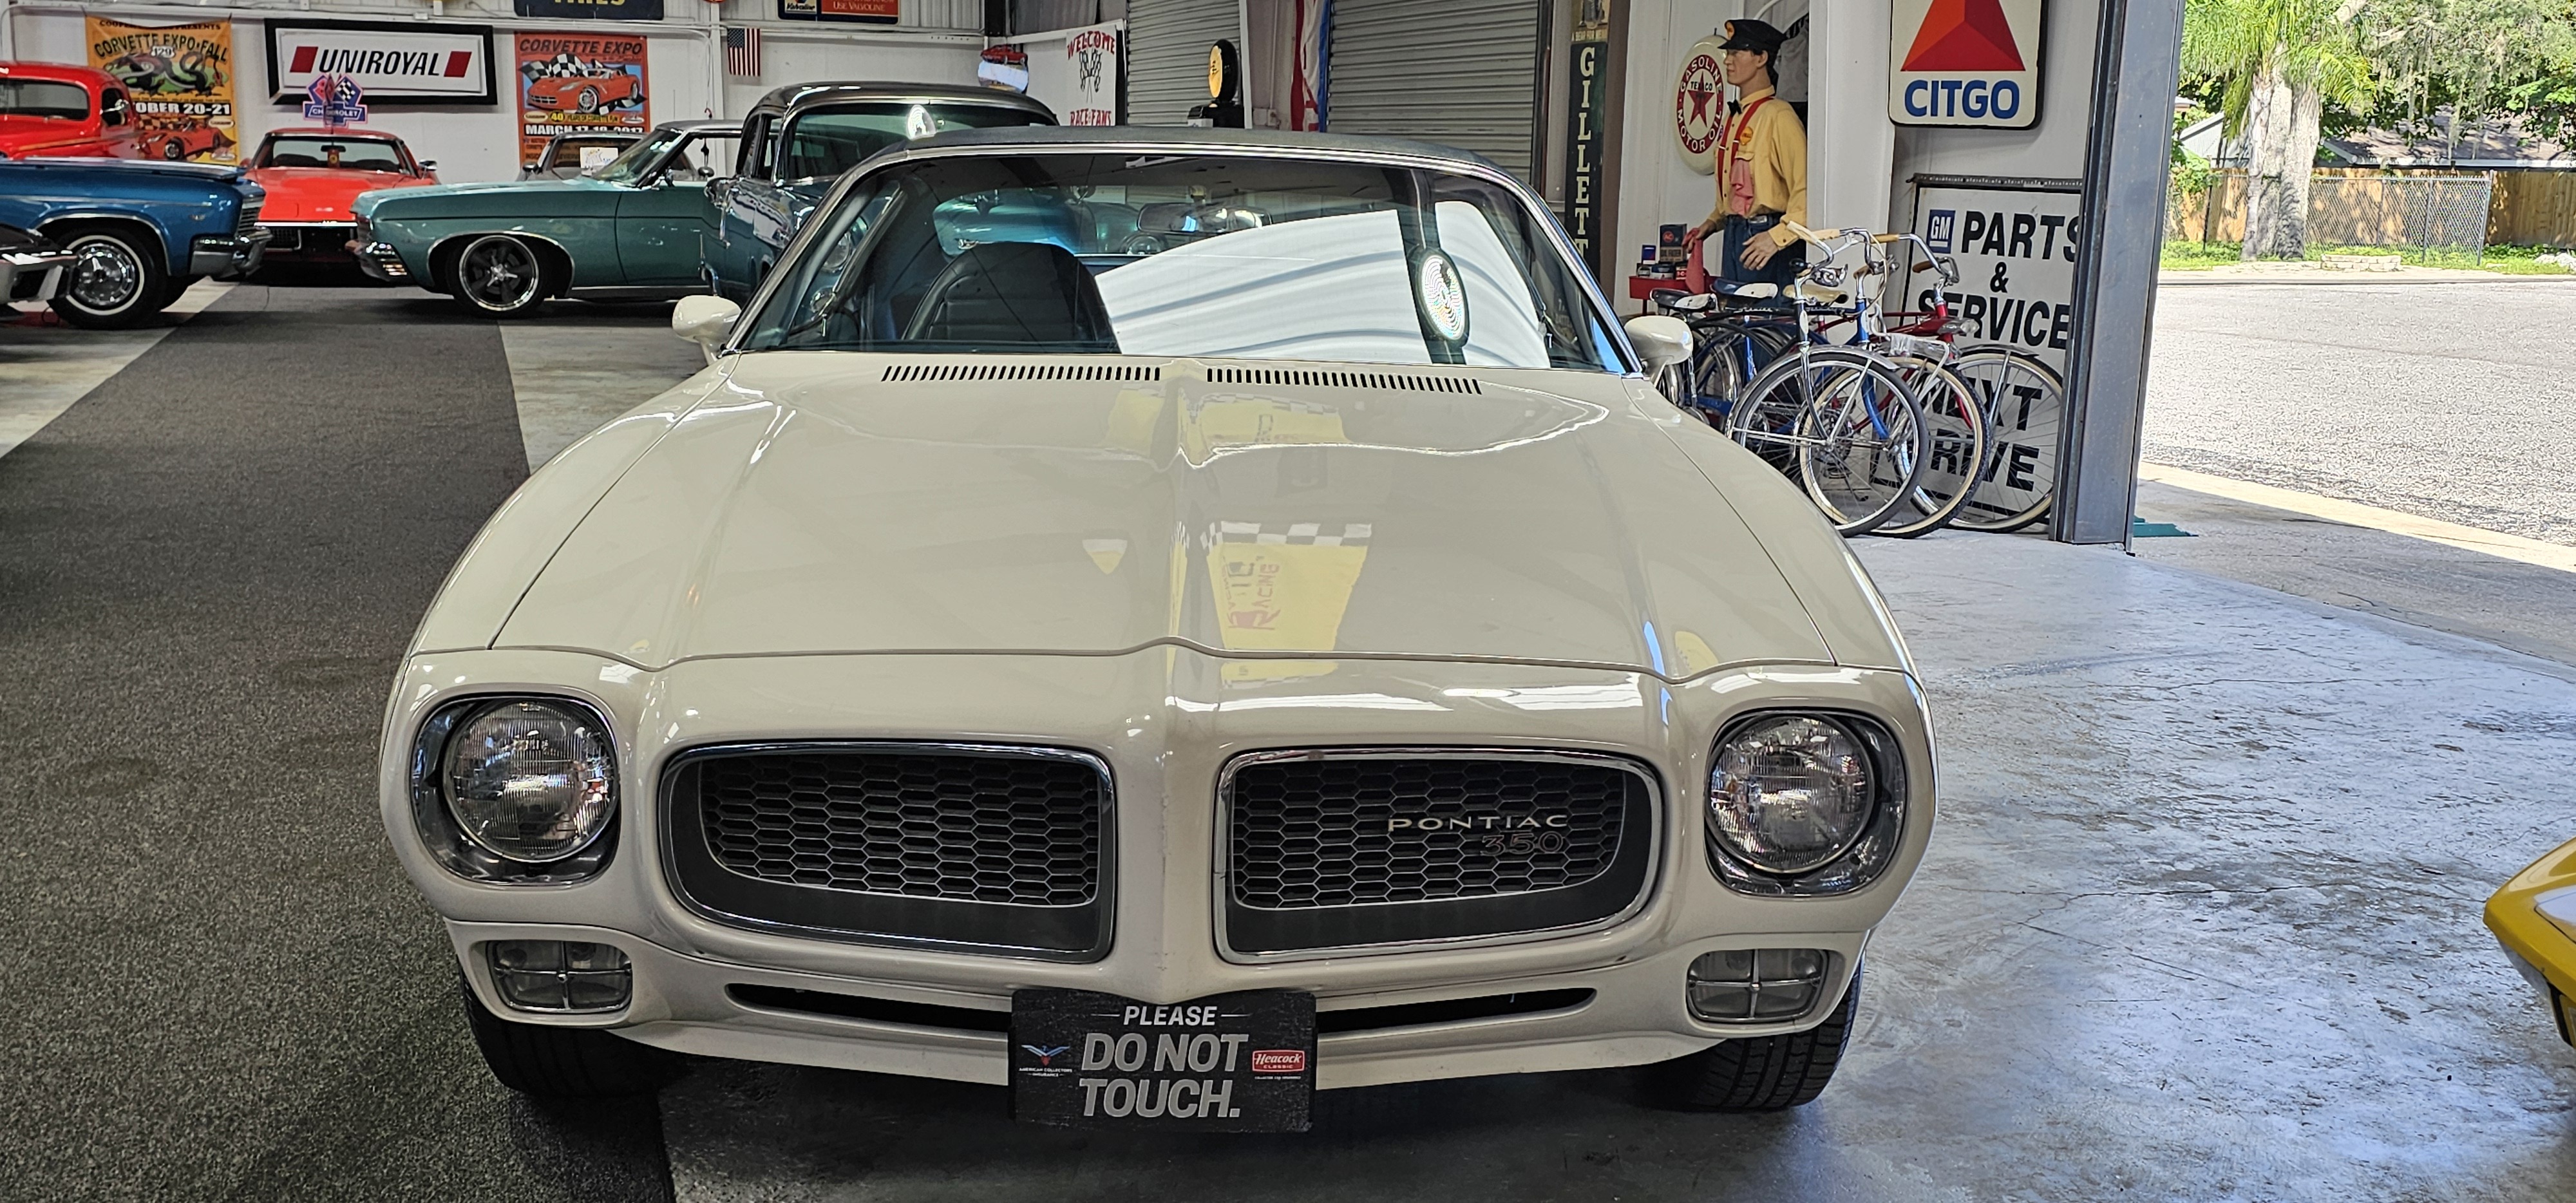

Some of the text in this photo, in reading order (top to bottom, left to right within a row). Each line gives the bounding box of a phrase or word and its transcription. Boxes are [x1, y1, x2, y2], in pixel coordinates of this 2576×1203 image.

[94, 33, 228, 62] CORVETTE EXPO FALL
[520, 39, 643, 55] CORVETTE EXPO
[1067, 31, 1115, 61] WELCOME
[319, 50, 440, 76] UNIROYAL
[1680, 56, 1723, 94] GASOLINE
[1690, 81, 1713, 91] TECO
[135, 102, 230, 115] OBER 20-21
[312, 108, 358, 117] CHROLET
[1904, 80, 2020, 120] CITGO
[551, 112, 564, 120] 40
[1070, 108, 1088, 126] RACE
[525, 124, 573, 135] MARCH
[1678, 109, 1722, 152] MOTOR OIL
[1930, 216, 1951, 240] GM
[1961, 211, 2079, 263] PARTS
[1990, 261, 2009, 294] &
[1909, 424, 2040, 492] RIVE
[1388, 815, 1567, 831] PONTIAC
[1480, 831, 1564, 857] 350
[1123, 1006, 1218, 1025] PLEASE
[1081, 1033, 1249, 1072] DO NOT
[1255, 1053, 1302, 1065] Heacock
[1079, 1079, 1240, 1118] TOUCH.
